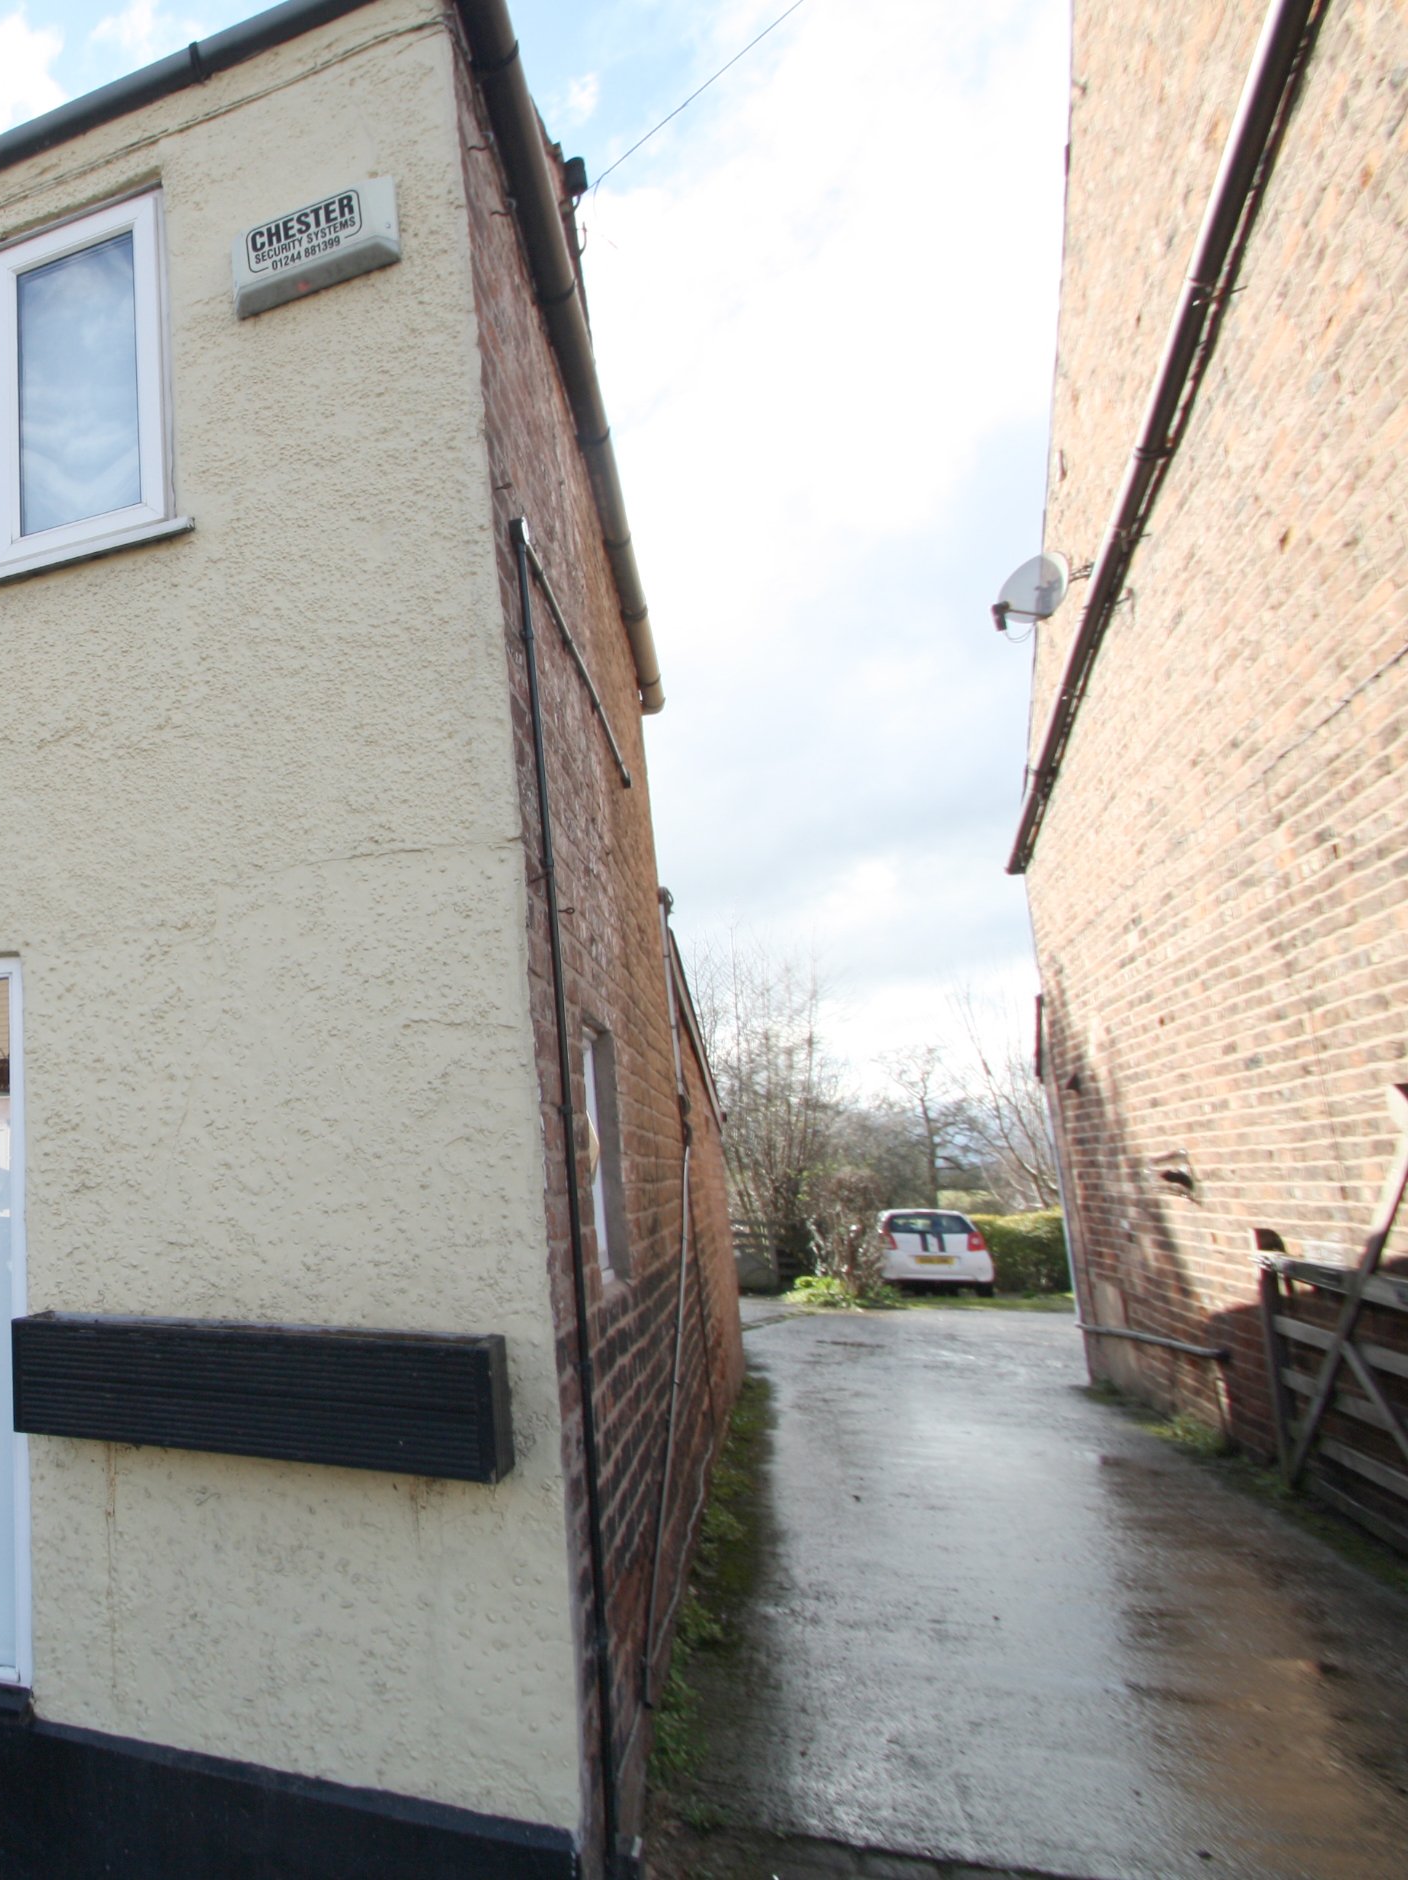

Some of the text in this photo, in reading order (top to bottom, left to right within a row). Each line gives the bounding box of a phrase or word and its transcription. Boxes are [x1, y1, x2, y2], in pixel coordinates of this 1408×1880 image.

[250, 194, 355, 253] CHESTER
[255, 216, 356, 264] SECURITY SYSTEMS
[271, 235, 341, 271] 01244 881399
